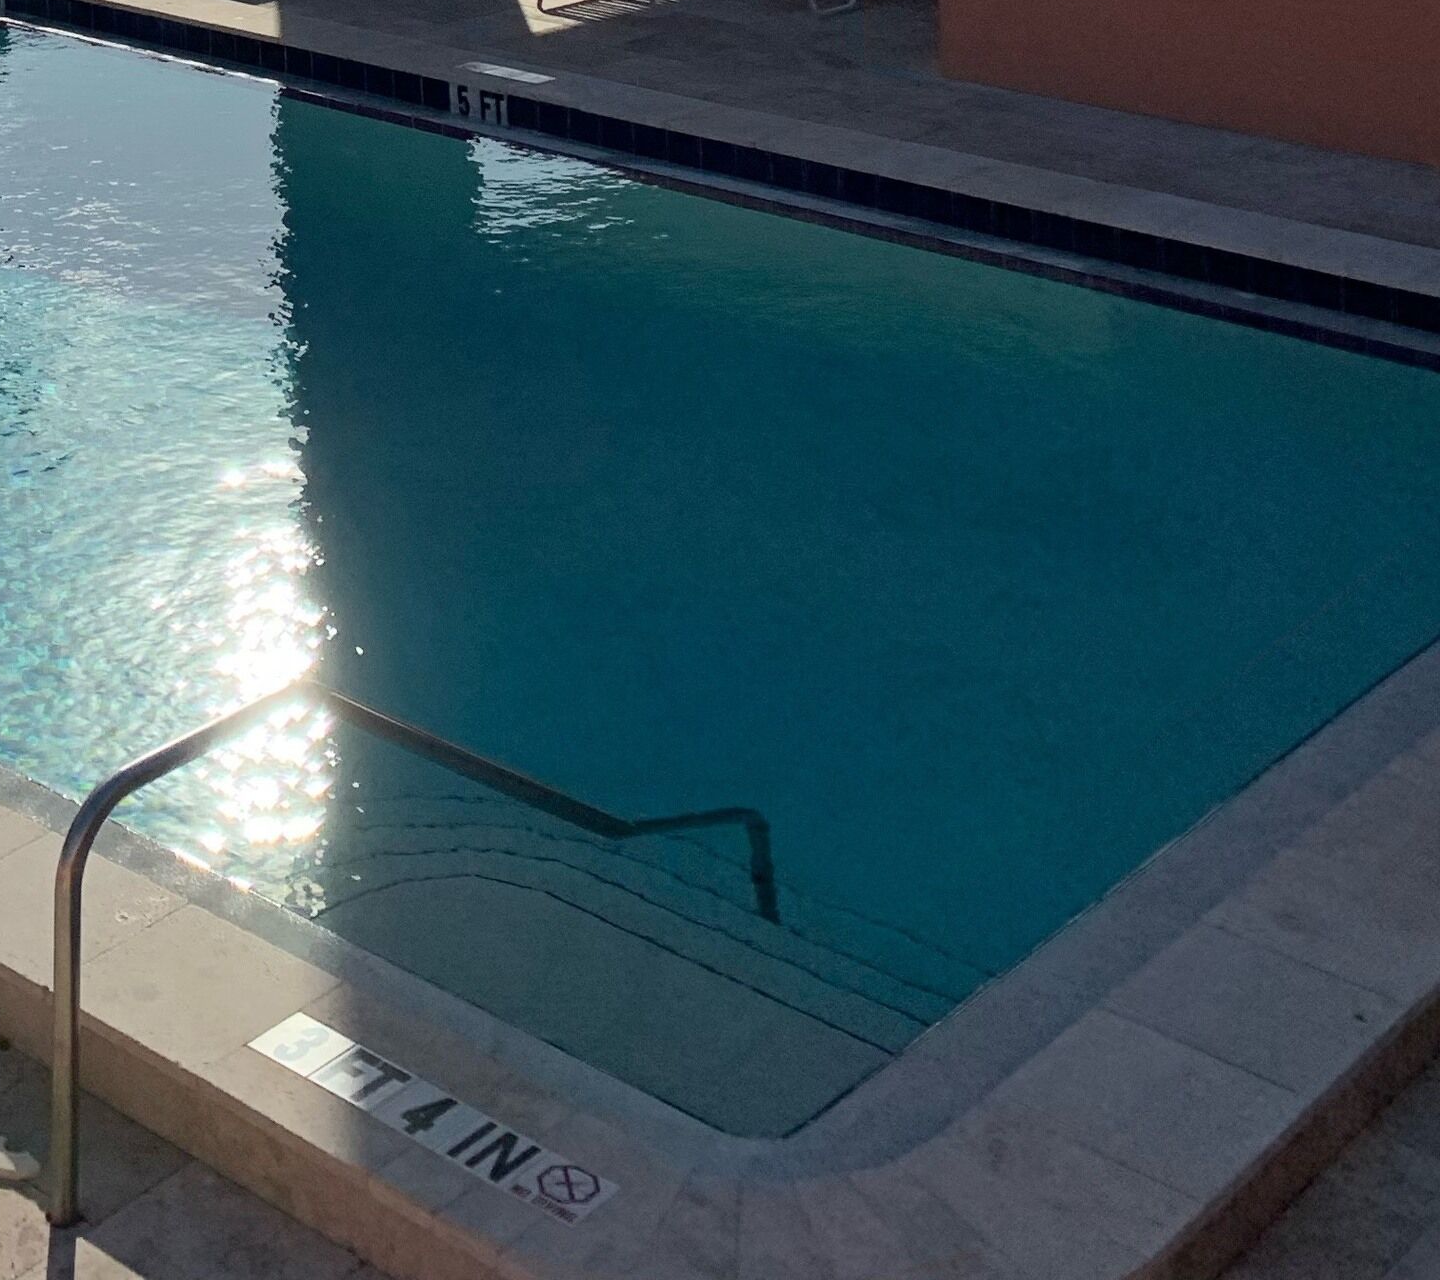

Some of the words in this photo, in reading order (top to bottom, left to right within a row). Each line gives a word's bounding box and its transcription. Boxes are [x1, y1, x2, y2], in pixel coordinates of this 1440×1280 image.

[457, 85, 470, 117] 5
[479, 90, 505, 125] FT
[273, 1027, 330, 1062] 3
[316, 1047, 412, 1102] FT
[401, 1097, 458, 1134] 4
[446, 1121, 542, 1182] IN
